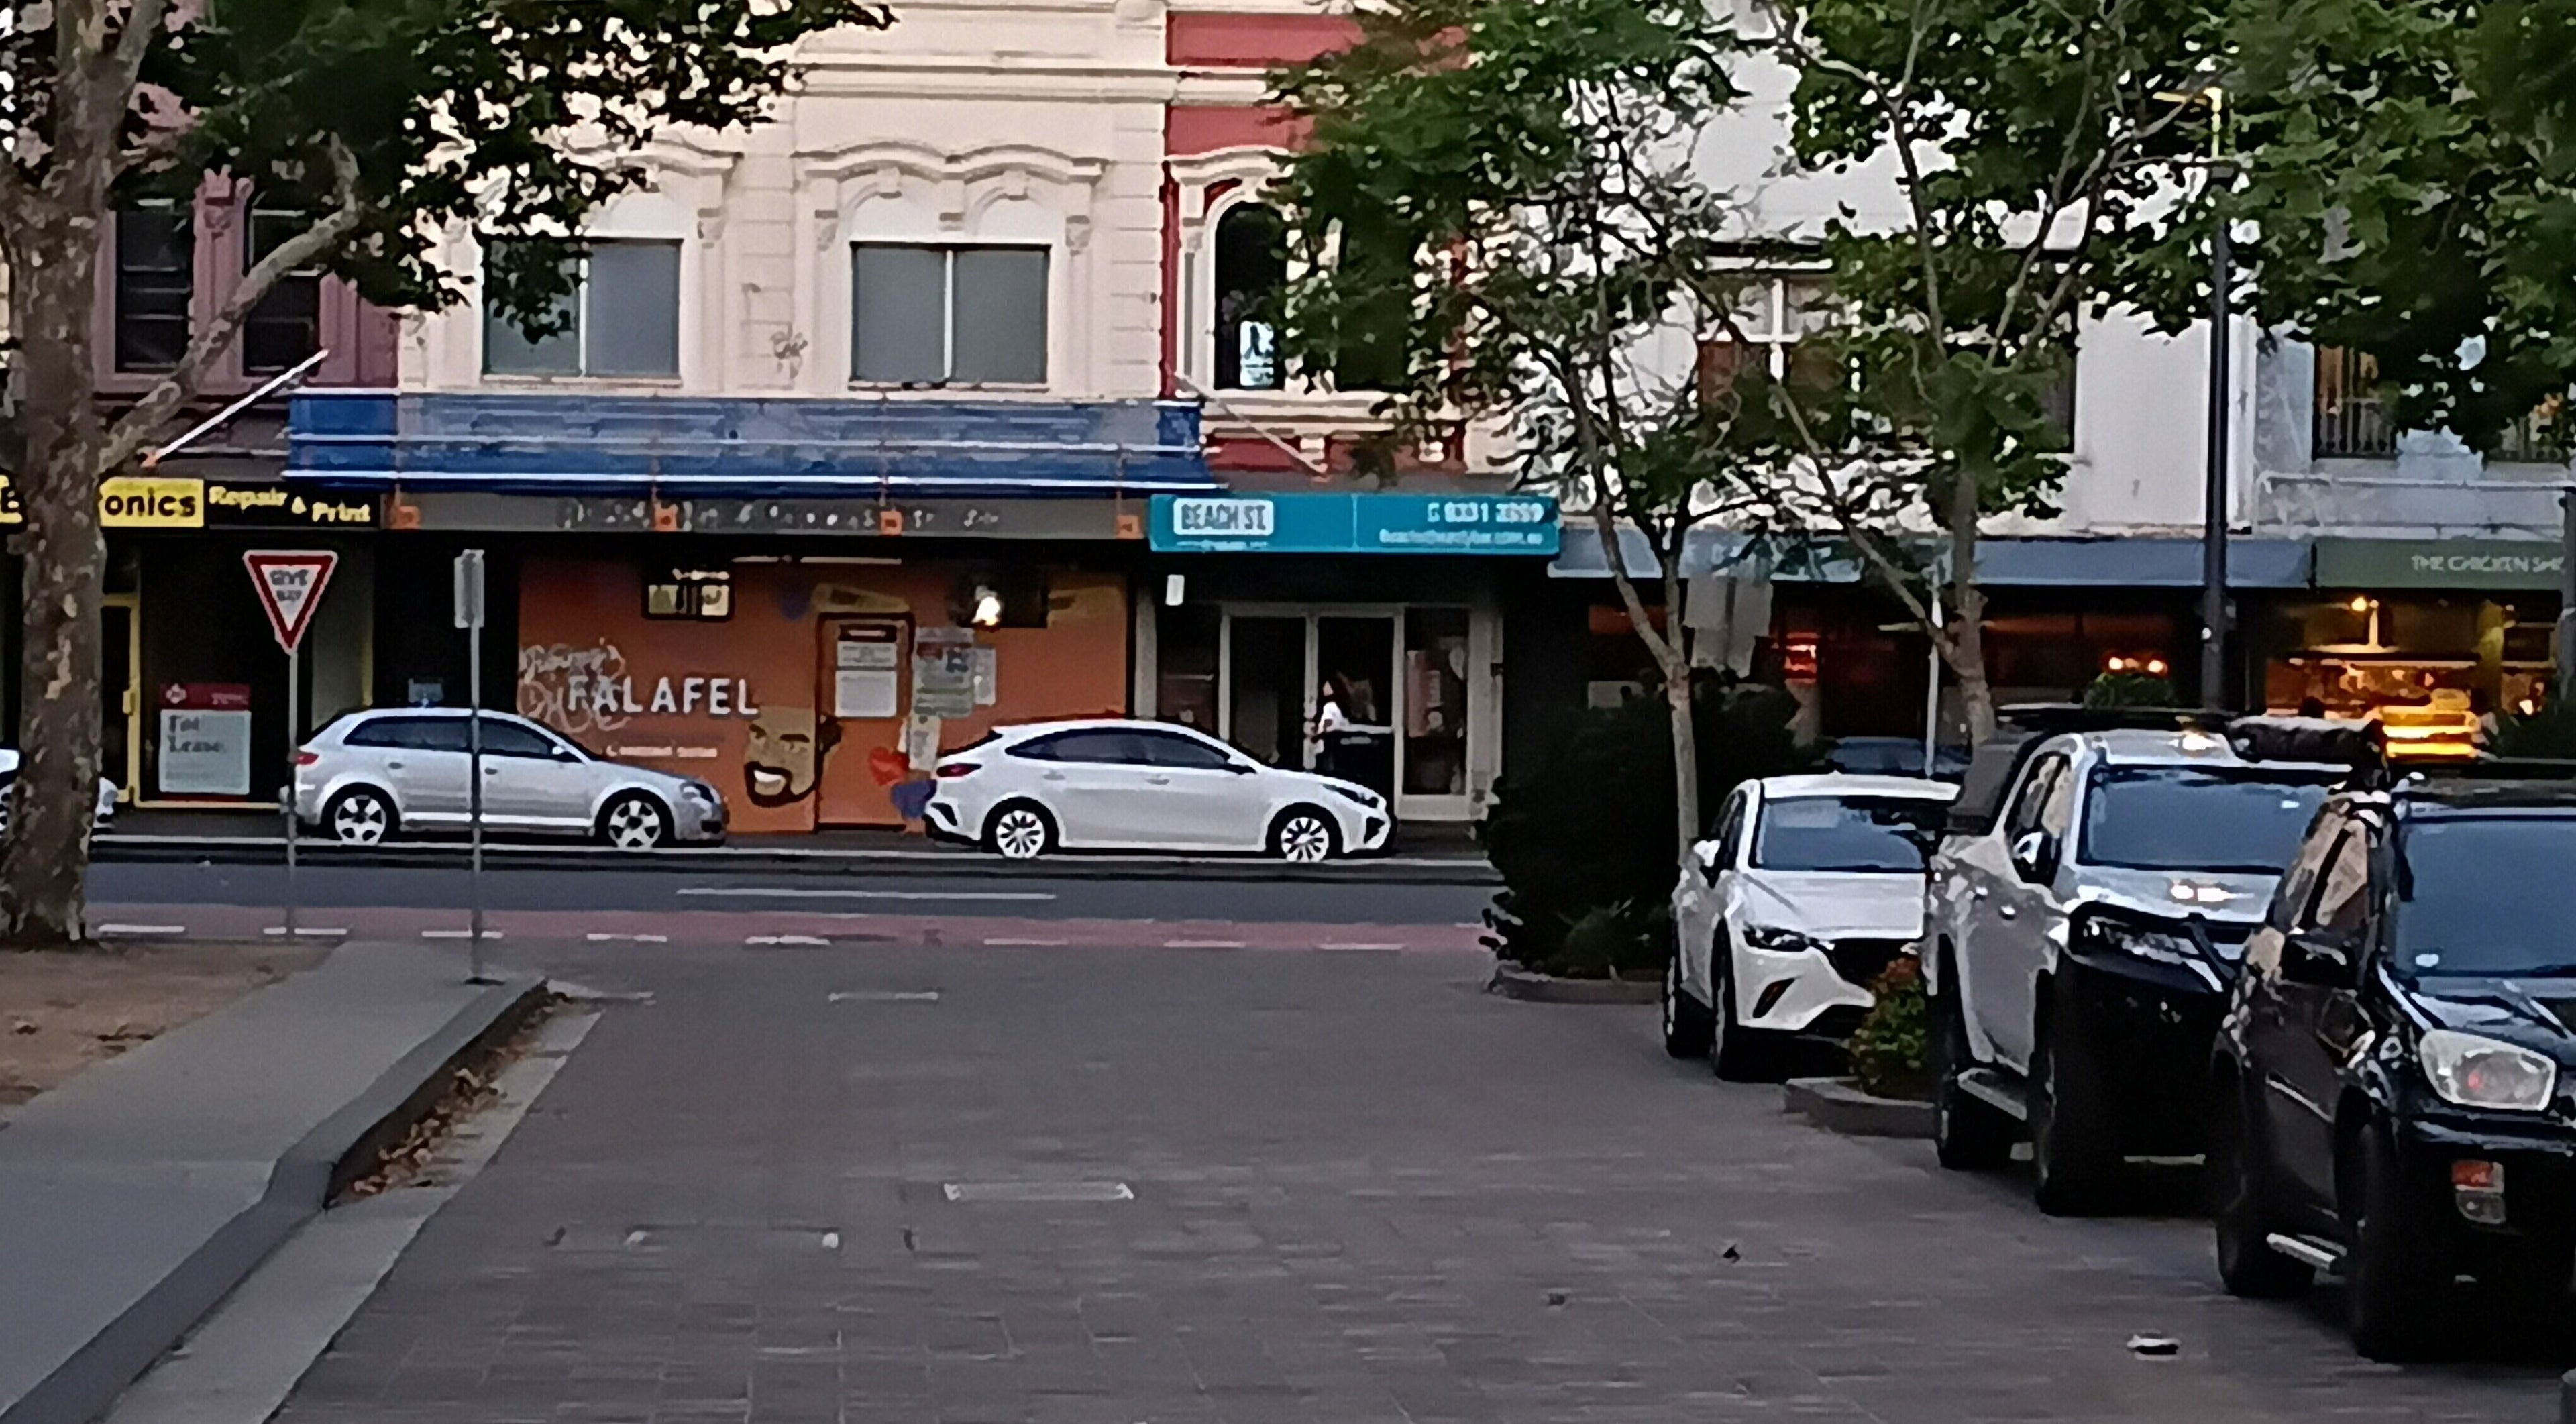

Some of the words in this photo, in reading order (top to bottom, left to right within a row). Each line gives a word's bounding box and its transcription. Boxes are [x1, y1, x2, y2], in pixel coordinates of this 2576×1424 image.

[209, 486, 288, 512] Repair
[312, 500, 370, 522] Print
[1181, 504, 1239, 530] BEACH
[2412, 555, 2444, 571] THE
[2447, 555, 2529, 572] CHICKEN
[568, 675, 759, 715] FALAFEL
